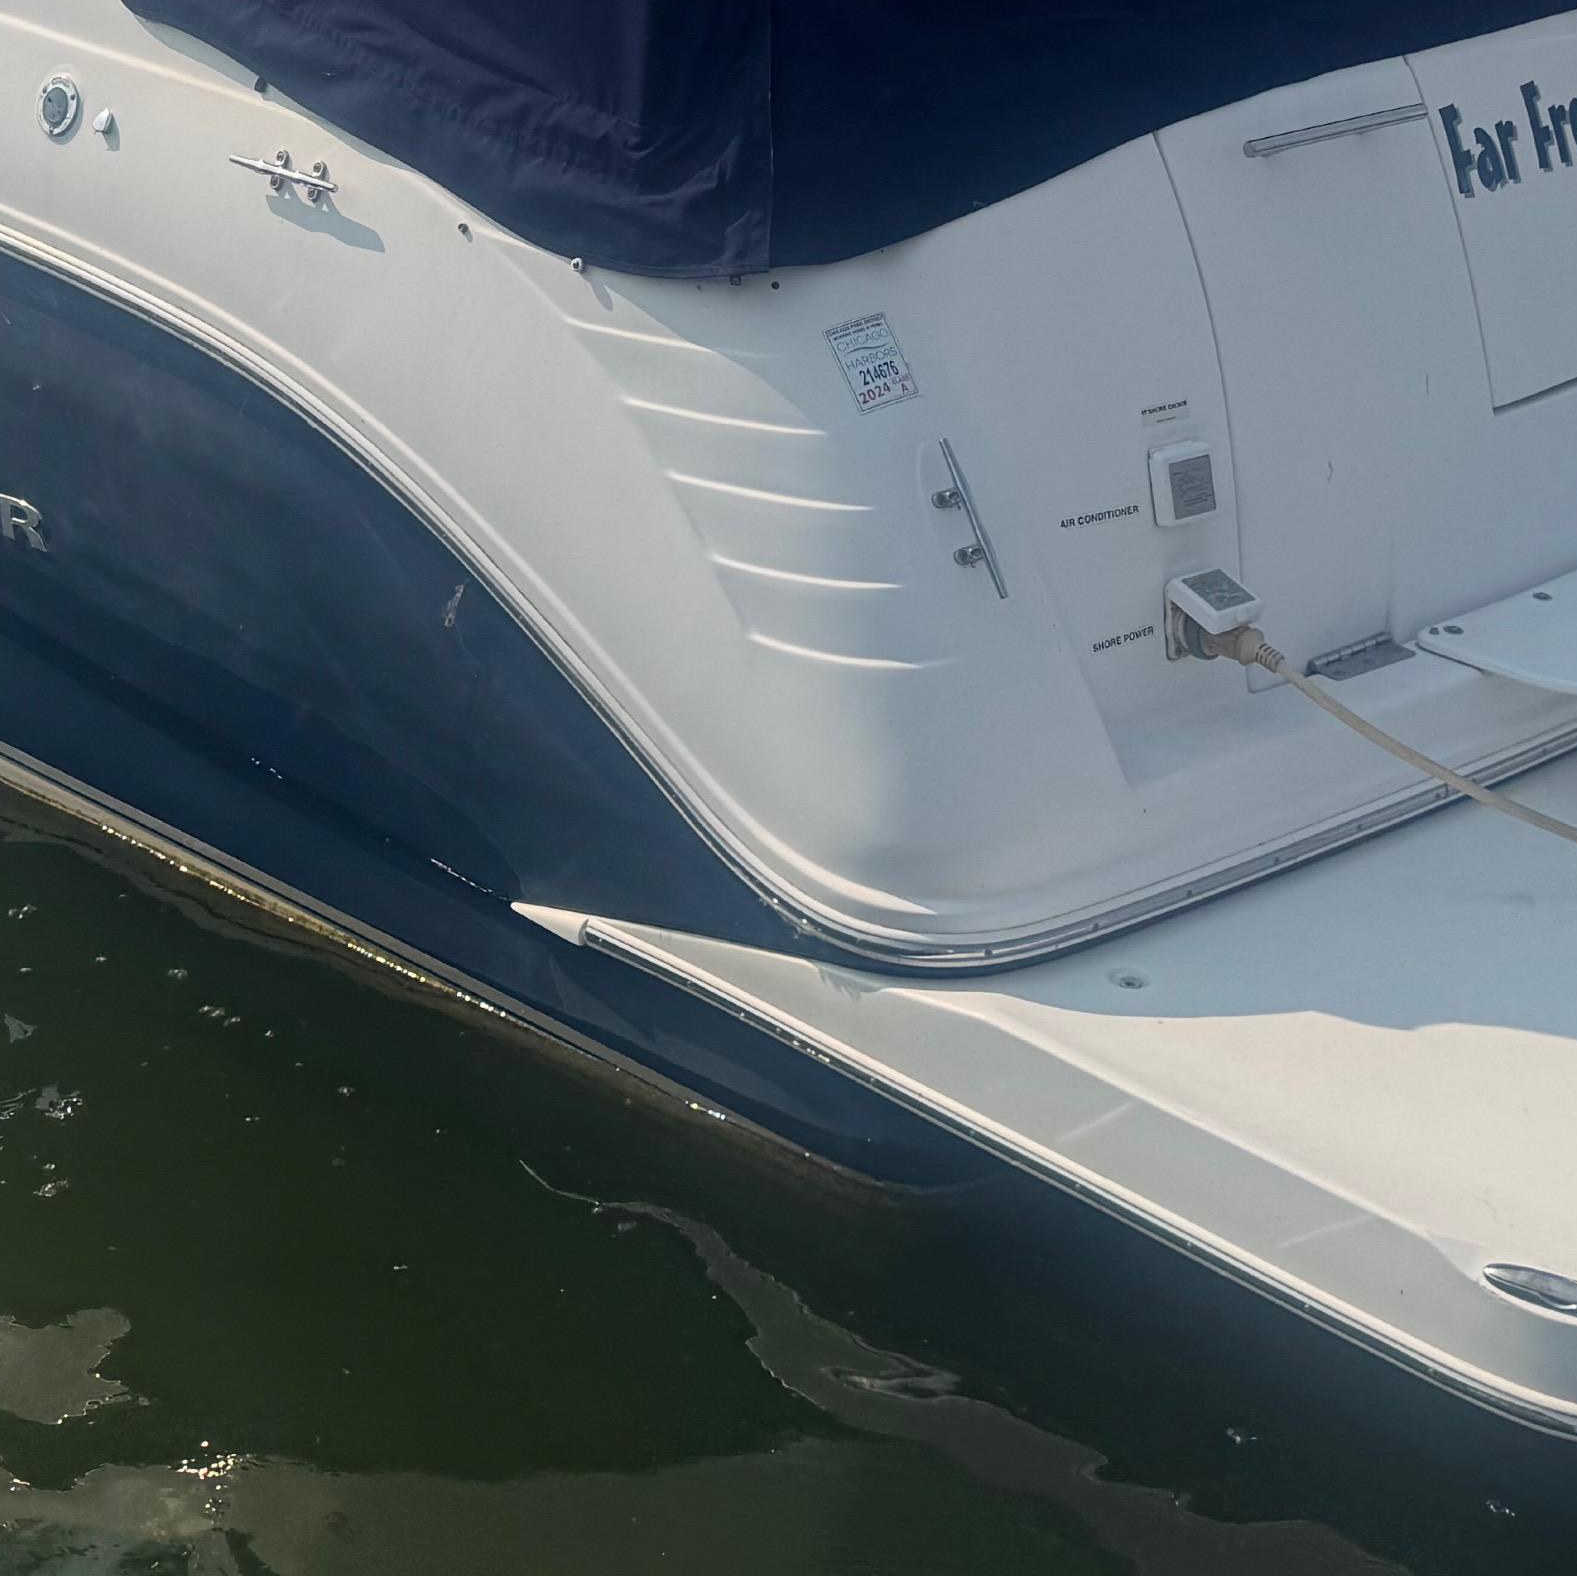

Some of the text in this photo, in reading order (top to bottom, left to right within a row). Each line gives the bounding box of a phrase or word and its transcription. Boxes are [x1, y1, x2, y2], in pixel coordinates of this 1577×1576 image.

[1438, 103, 1522, 198] Far
[837, 328, 889, 352] CHICAGO
[845, 346, 898, 371] HARBORS
[859, 360, 899, 386] 214676
[859, 382, 891, 405] 2024
[901, 383, 910, 395] A
[1060, 505, 1139, 528] AIR CONDITIONER
[1092, 625, 1154, 653] SHORE POWER
